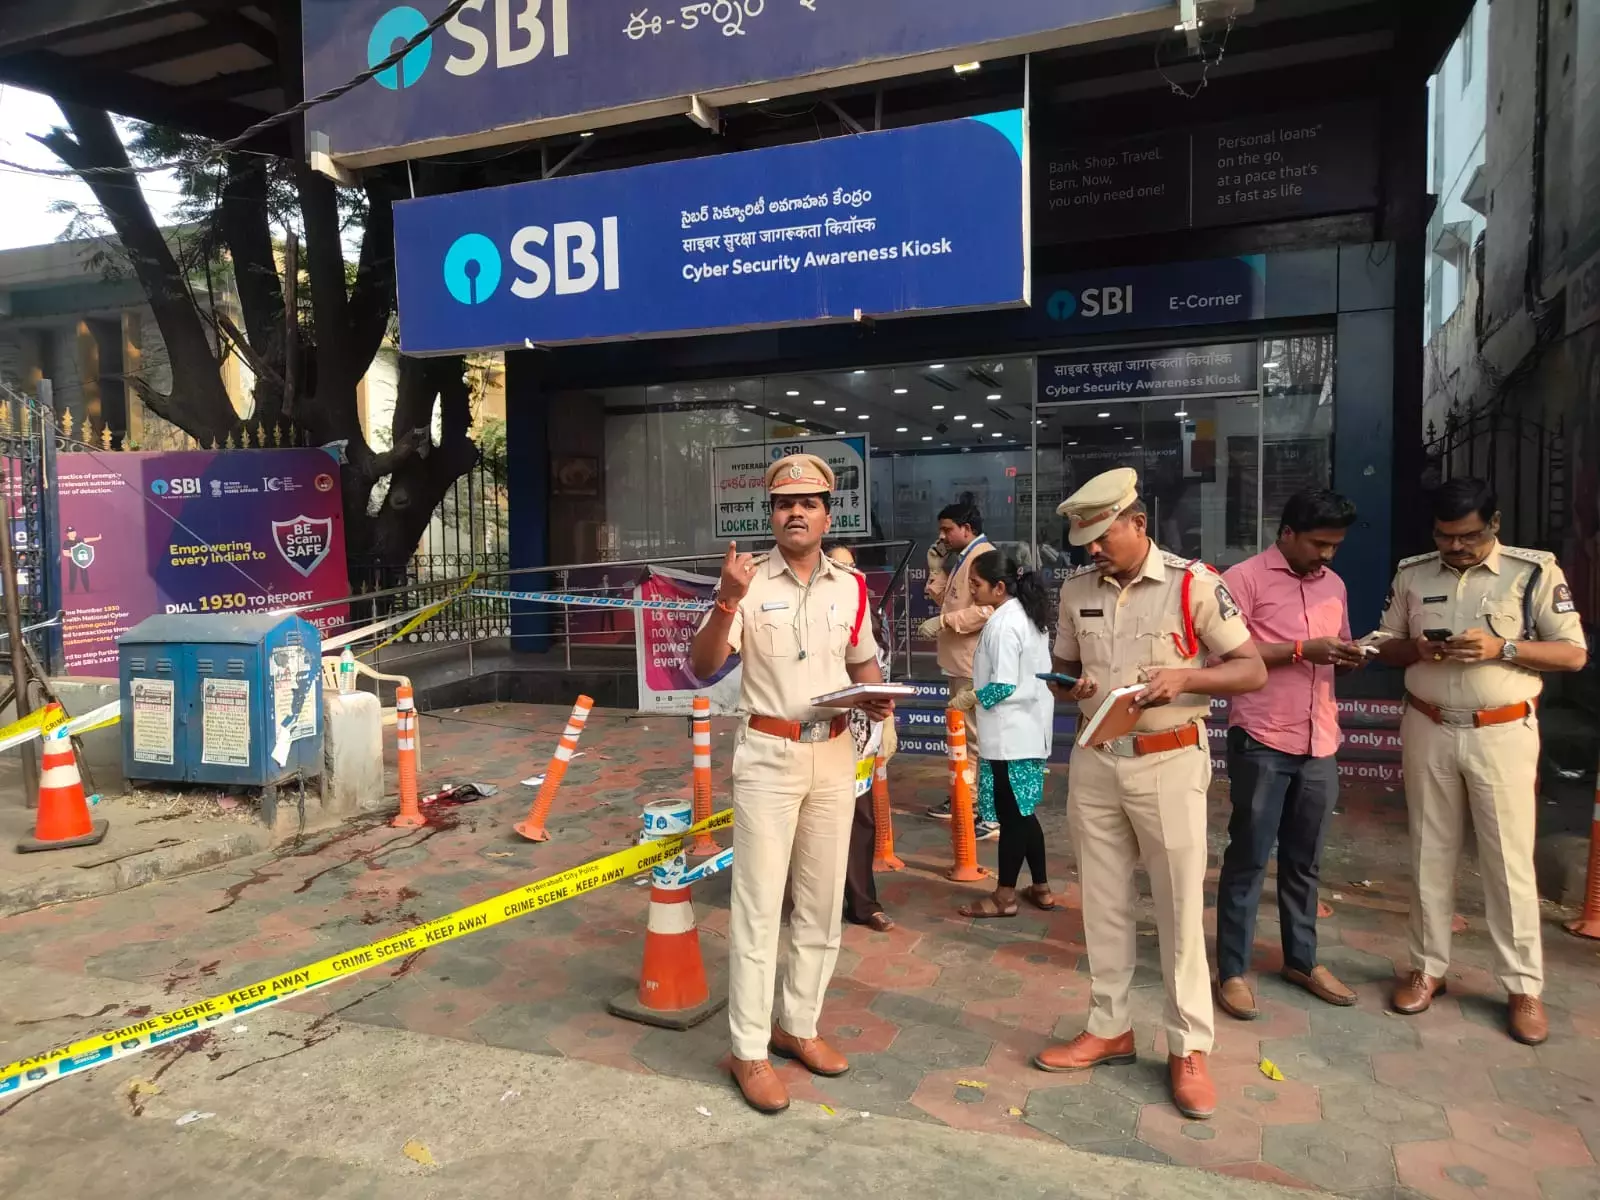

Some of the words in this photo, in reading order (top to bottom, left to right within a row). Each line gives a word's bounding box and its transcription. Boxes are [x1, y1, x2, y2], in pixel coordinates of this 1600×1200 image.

[444, 0, 569, 76] SBI
[1217, 131, 1276, 150] Personal
[1217, 156, 1234, 169] on
[1238, 152, 1260, 166] the
[1217, 175, 1230, 187] at
[1234, 174, 1241, 185] a
[1245, 169, 1277, 188] pace
[1048, 196, 1071, 210] you
[1074, 191, 1100, 207] only
[1103, 187, 1134, 201] need
[1137, 184, 1165, 197] one!
[1217, 194, 1232, 205] as
[1235, 188, 1261, 203] fast
[1262, 188, 1277, 200] as
[1280, 183, 1303, 198] life
[682, 236, 720, 253] साइबर
[723, 231, 756, 252] सुरक्षा
[759, 223, 822, 243] जागरूकता
[510, 216, 620, 299] SBI
[682, 261, 729, 283] Cyber
[731, 254, 800, 275] Security
[804, 244, 898, 267] Awareness
[901, 237, 952, 257] Kiosk
[1080, 284, 1133, 318] SBI
[1169, 293, 1243, 310] E-Corner
[1054, 362, 1090, 377] साइबर
[1092, 360, 1123, 378] सुरक्षा
[1045, 381, 1081, 398] Cyber
[1083, 379, 1133, 394] Security
[1135, 374, 1203, 391] Awareness
[1205, 372, 1241, 385] Kiosk
[171, 477, 201, 495] SBI
[294, 523, 313, 535] BE
[721, 518, 759, 533] LOCKER
[831, 514, 861, 528] LABLE
[287, 533, 322, 546] Scam
[170, 540, 252, 557] Empowering
[287, 544, 322, 558] SAFE
[171, 554, 208, 567] every
[211, 552, 250, 564] Indian
[252, 550, 266, 560] to
[165, 602, 198, 615] DIAL
[199, 592, 246, 612] 1930
[248, 595, 266, 606] TO
[267, 590, 314, 605] REPORT
[327, 615, 345, 625] ON
[651, 610, 662, 622] to
[667, 611, 700, 624] every
[681, 627, 697, 641] giv
[652, 642, 692, 655] power
[653, 658, 686, 670] every
[916, 686, 937, 696] you
[909, 713, 930, 724] you
[933, 715, 947, 724] on
[900, 740, 922, 751] you
[1350, 732, 1383, 747] only
[1359, 765, 1393, 780] only
[707, 812, 733, 829] SCENE
[637, 852, 662, 869] CRIME
[525, 876, 564, 893] Hyderabad
[564, 871, 579, 881] City
[579, 864, 600, 875] Police
[504, 898, 536, 916] CRIME
[537, 886, 569, 905] SCENE
[576, 876, 599, 892] KEEP
[601, 866, 625, 883] AWAY
[332, 951, 374, 971] CRIME
[376, 937, 417, 958] SCENE
[425, 925, 455, 943] KEEP
[458, 913, 488, 932] AWAY
[102, 1018, 158, 1041] CRIME
[162, 1000, 216, 1024] SCENE
[228, 985, 267, 1004] KEEP
[273, 971, 311, 991] AWAY
[19, 1046, 71, 1067] AWAY
